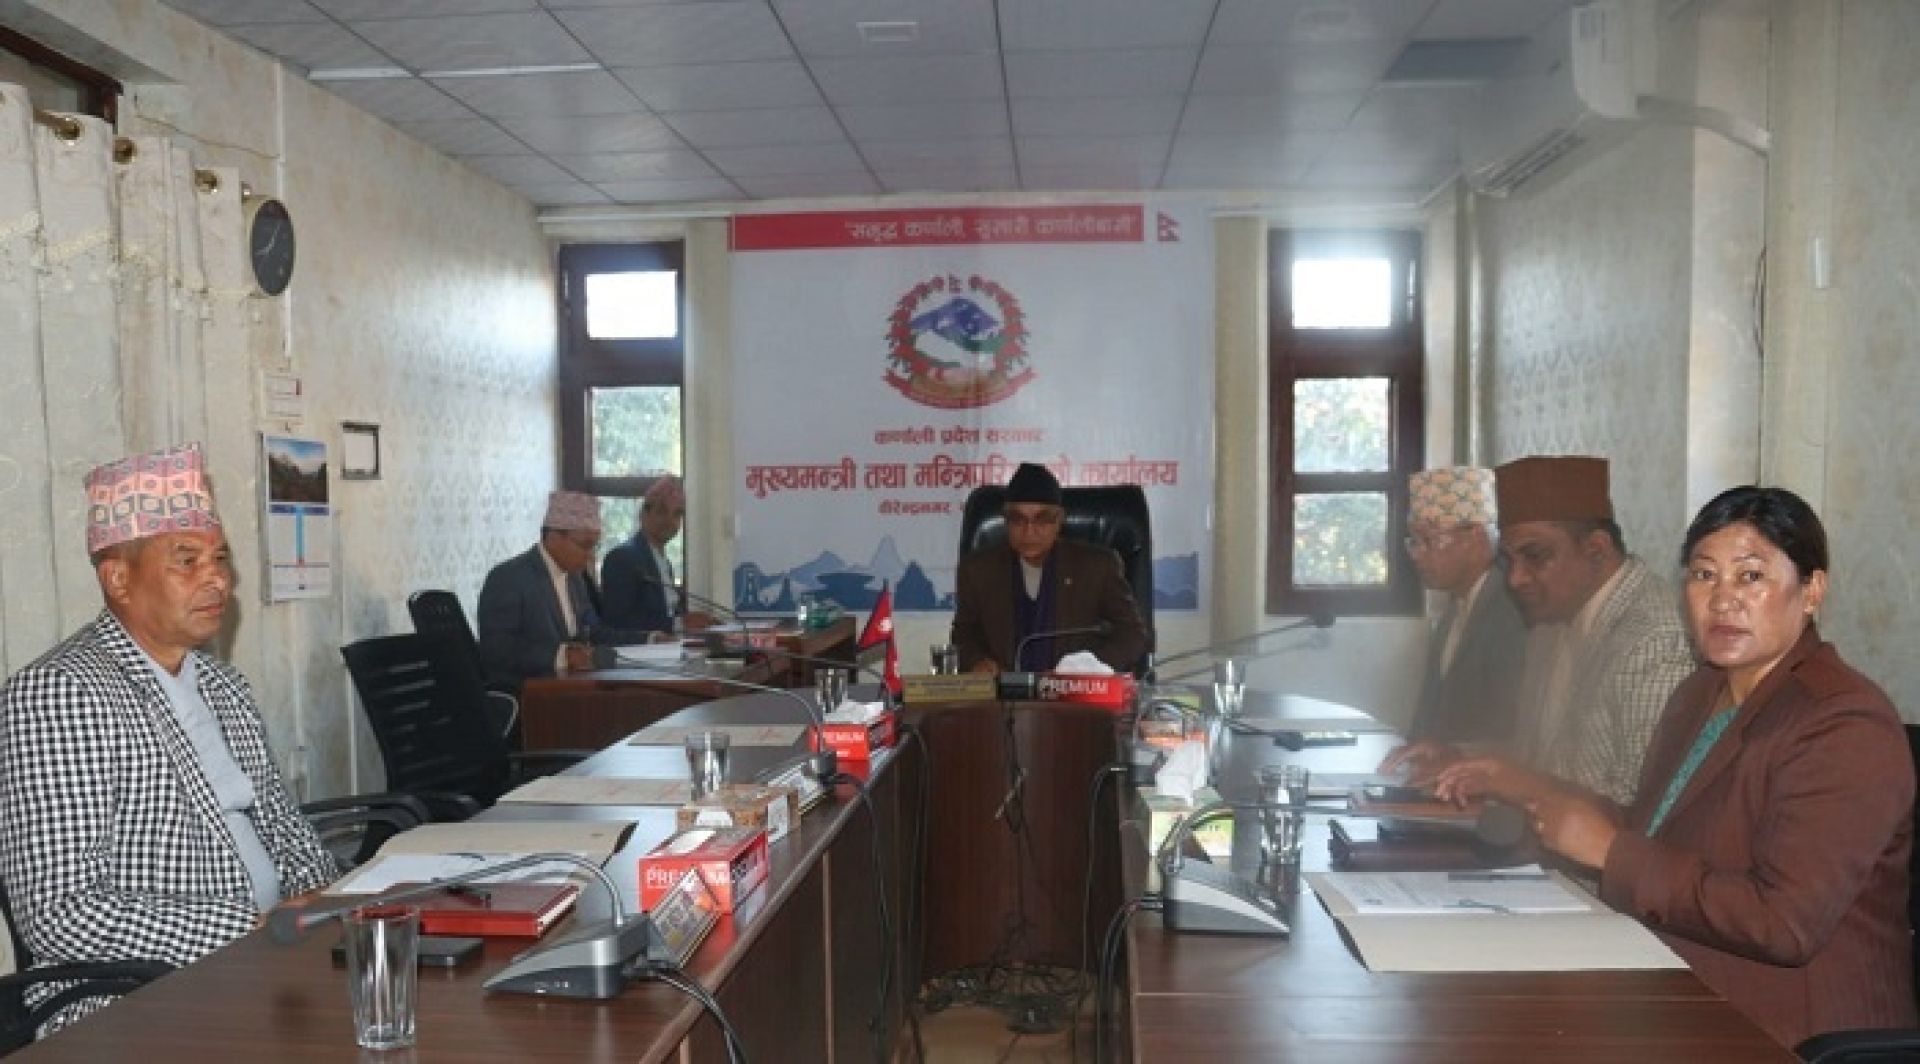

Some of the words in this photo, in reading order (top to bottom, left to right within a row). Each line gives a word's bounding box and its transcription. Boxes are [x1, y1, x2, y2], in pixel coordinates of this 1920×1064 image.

[940, 424, 980, 445] प्रदेश
[985, 426, 1044, 444] सरकार
[745, 455, 857, 499] मुख्यमन्त्री
[863, 462, 908, 490] तथा
[1080, 454, 1180, 488] कार्यालय
